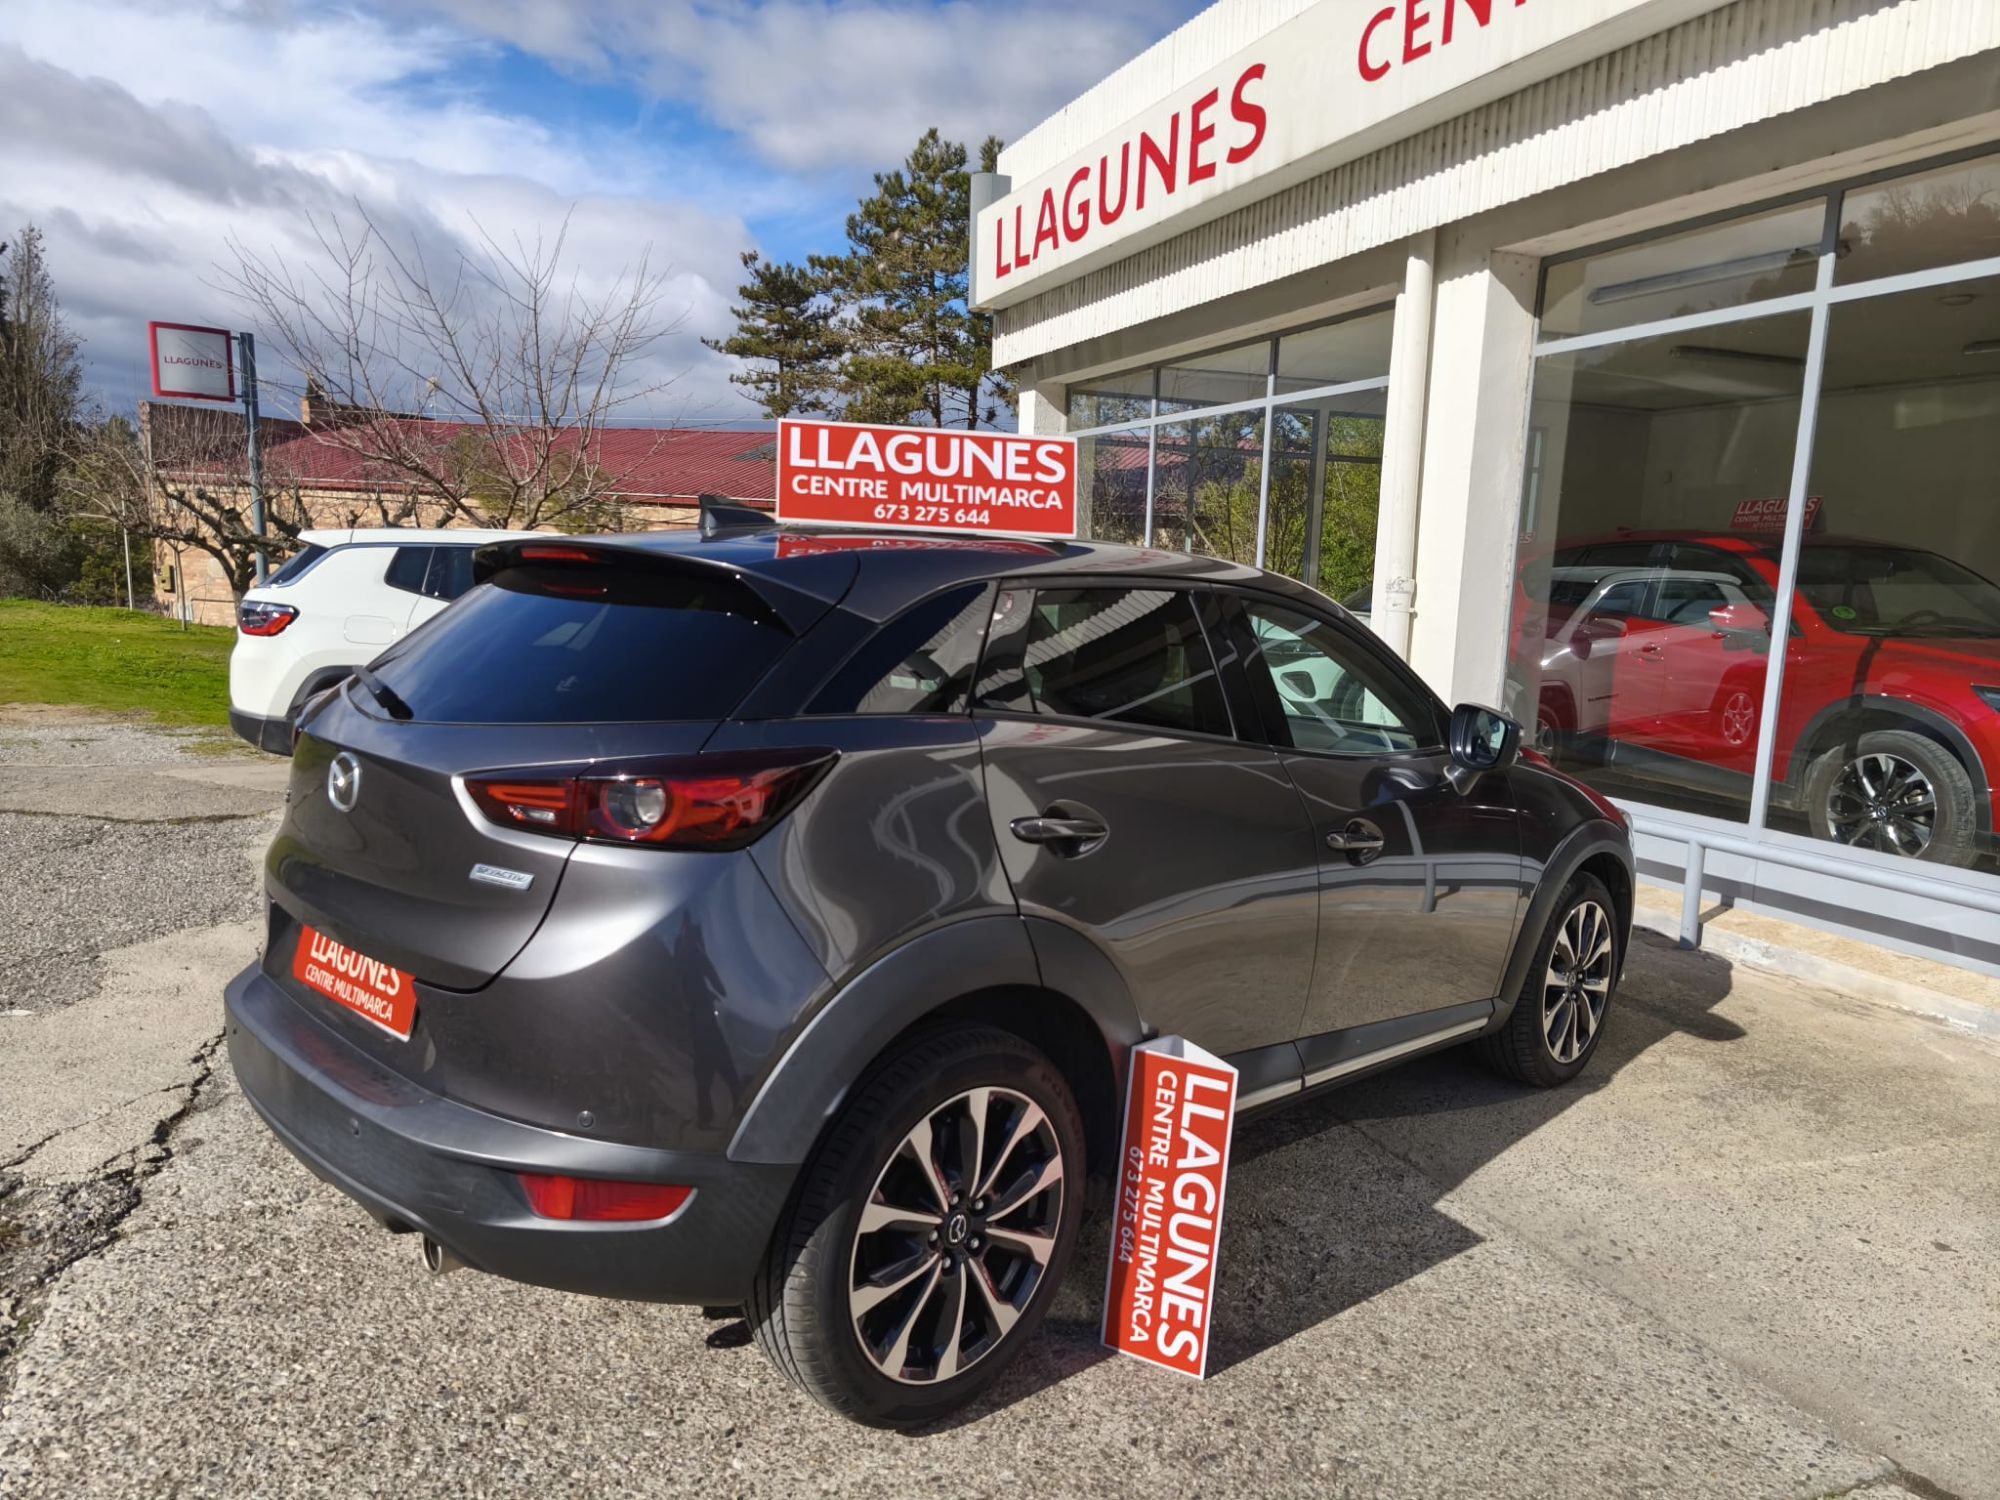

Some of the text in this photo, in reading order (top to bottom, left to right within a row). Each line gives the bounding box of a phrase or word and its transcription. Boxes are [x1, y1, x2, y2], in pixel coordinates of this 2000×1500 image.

[996, 63, 1267, 279] LLAGUNES
[164, 355, 222, 368] LLAGUNES
[789, 426, 1066, 484] LLAGUNES
[792, 474, 1063, 510] CENTRE MULTIMARCA
[874, 503, 990, 525] 673 275 644
[304, 963, 394, 1022] CENTRE MULTIMARCA
[1118, 1145, 1143, 1264] 673 275 644
[1129, 1069, 1178, 1342] CENTRE MULTIMARCA
[1156, 1072, 1229, 1363] LLAGUNES
